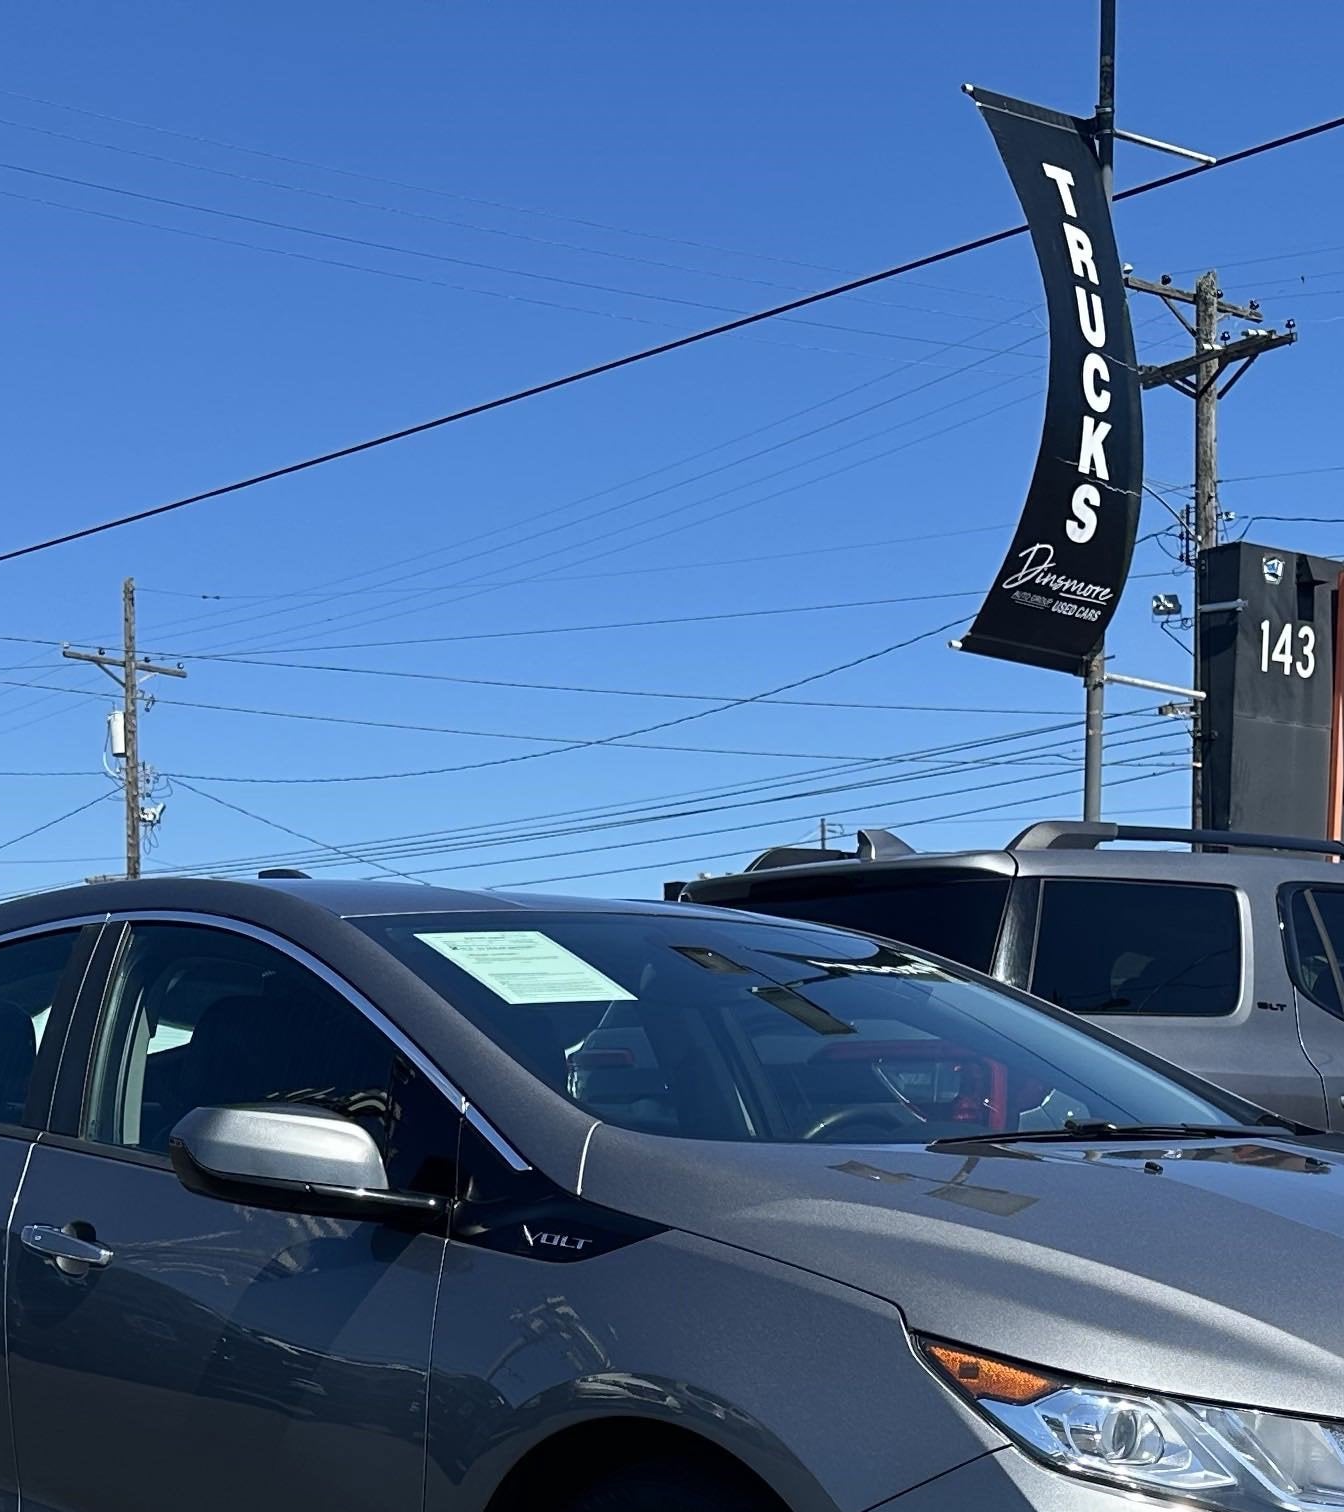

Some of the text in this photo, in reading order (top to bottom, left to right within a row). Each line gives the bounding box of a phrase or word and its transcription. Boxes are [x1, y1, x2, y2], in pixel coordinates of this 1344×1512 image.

[1042, 162, 1112, 544] TRUCKS
[1002, 543, 1114, 601] Dinsmore
[1051, 600, 1101, 621] USED CARS
[1261, 620, 1315, 678] 143
[522, 1224, 593, 1249] VOLT
